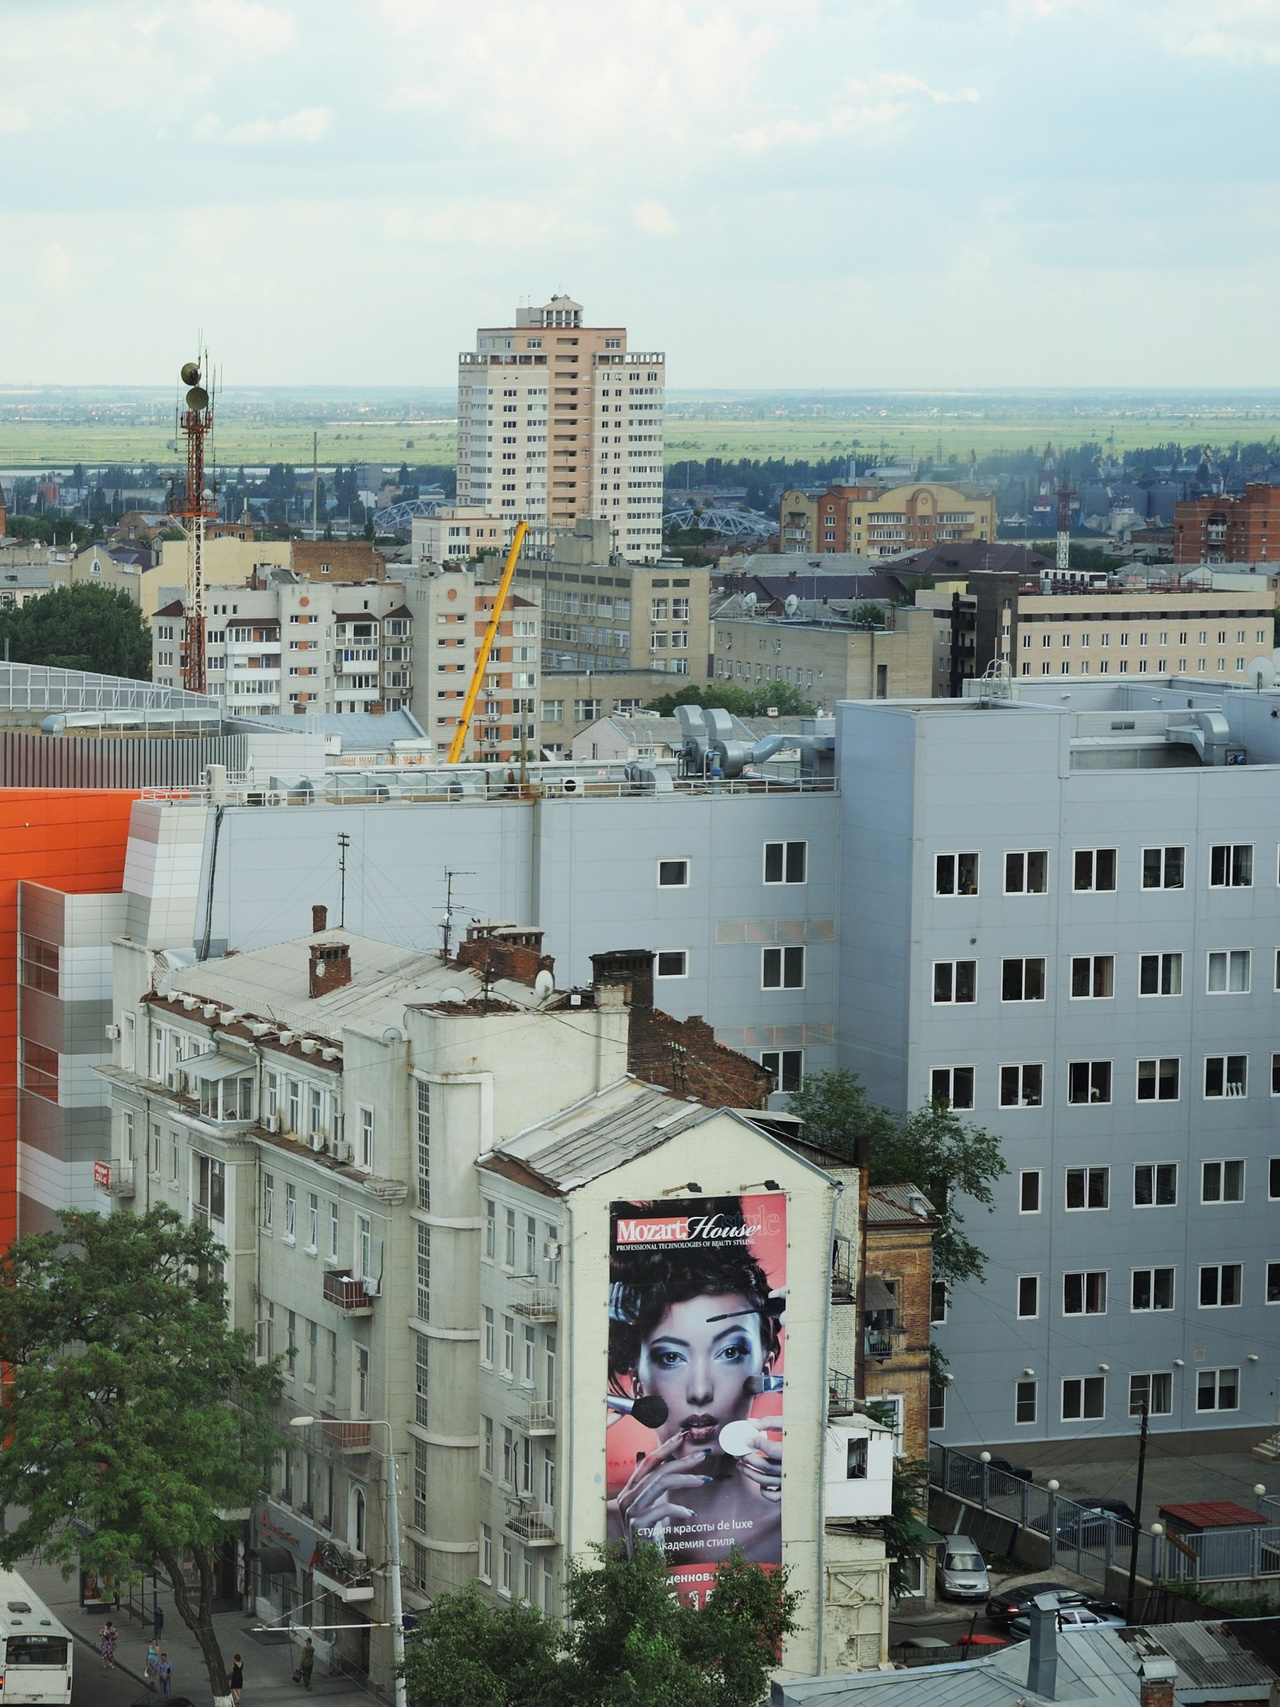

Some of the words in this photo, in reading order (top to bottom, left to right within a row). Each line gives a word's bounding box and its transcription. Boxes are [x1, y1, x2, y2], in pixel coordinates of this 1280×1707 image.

[617, 1220, 687, 1242] Mozart
[684, 1213, 762, 1241] House
[616, 1244, 658, 1252] PROFESSIONAL
[658, 1241, 702, 1250] TECHNOLOGIES
[702, 1240, 711, 1248] OF
[712, 1239, 732, 1247] BEAUTY
[732, 1238, 756, 1246] STYLING
[637, 1525, 672, 1537] студия
[673, 1523, 715, 1535] красоты
[717, 1519, 730, 1530] de
[732, 1519, 753, 1529] luxe
[706, 1537, 735, 1547] стиля
